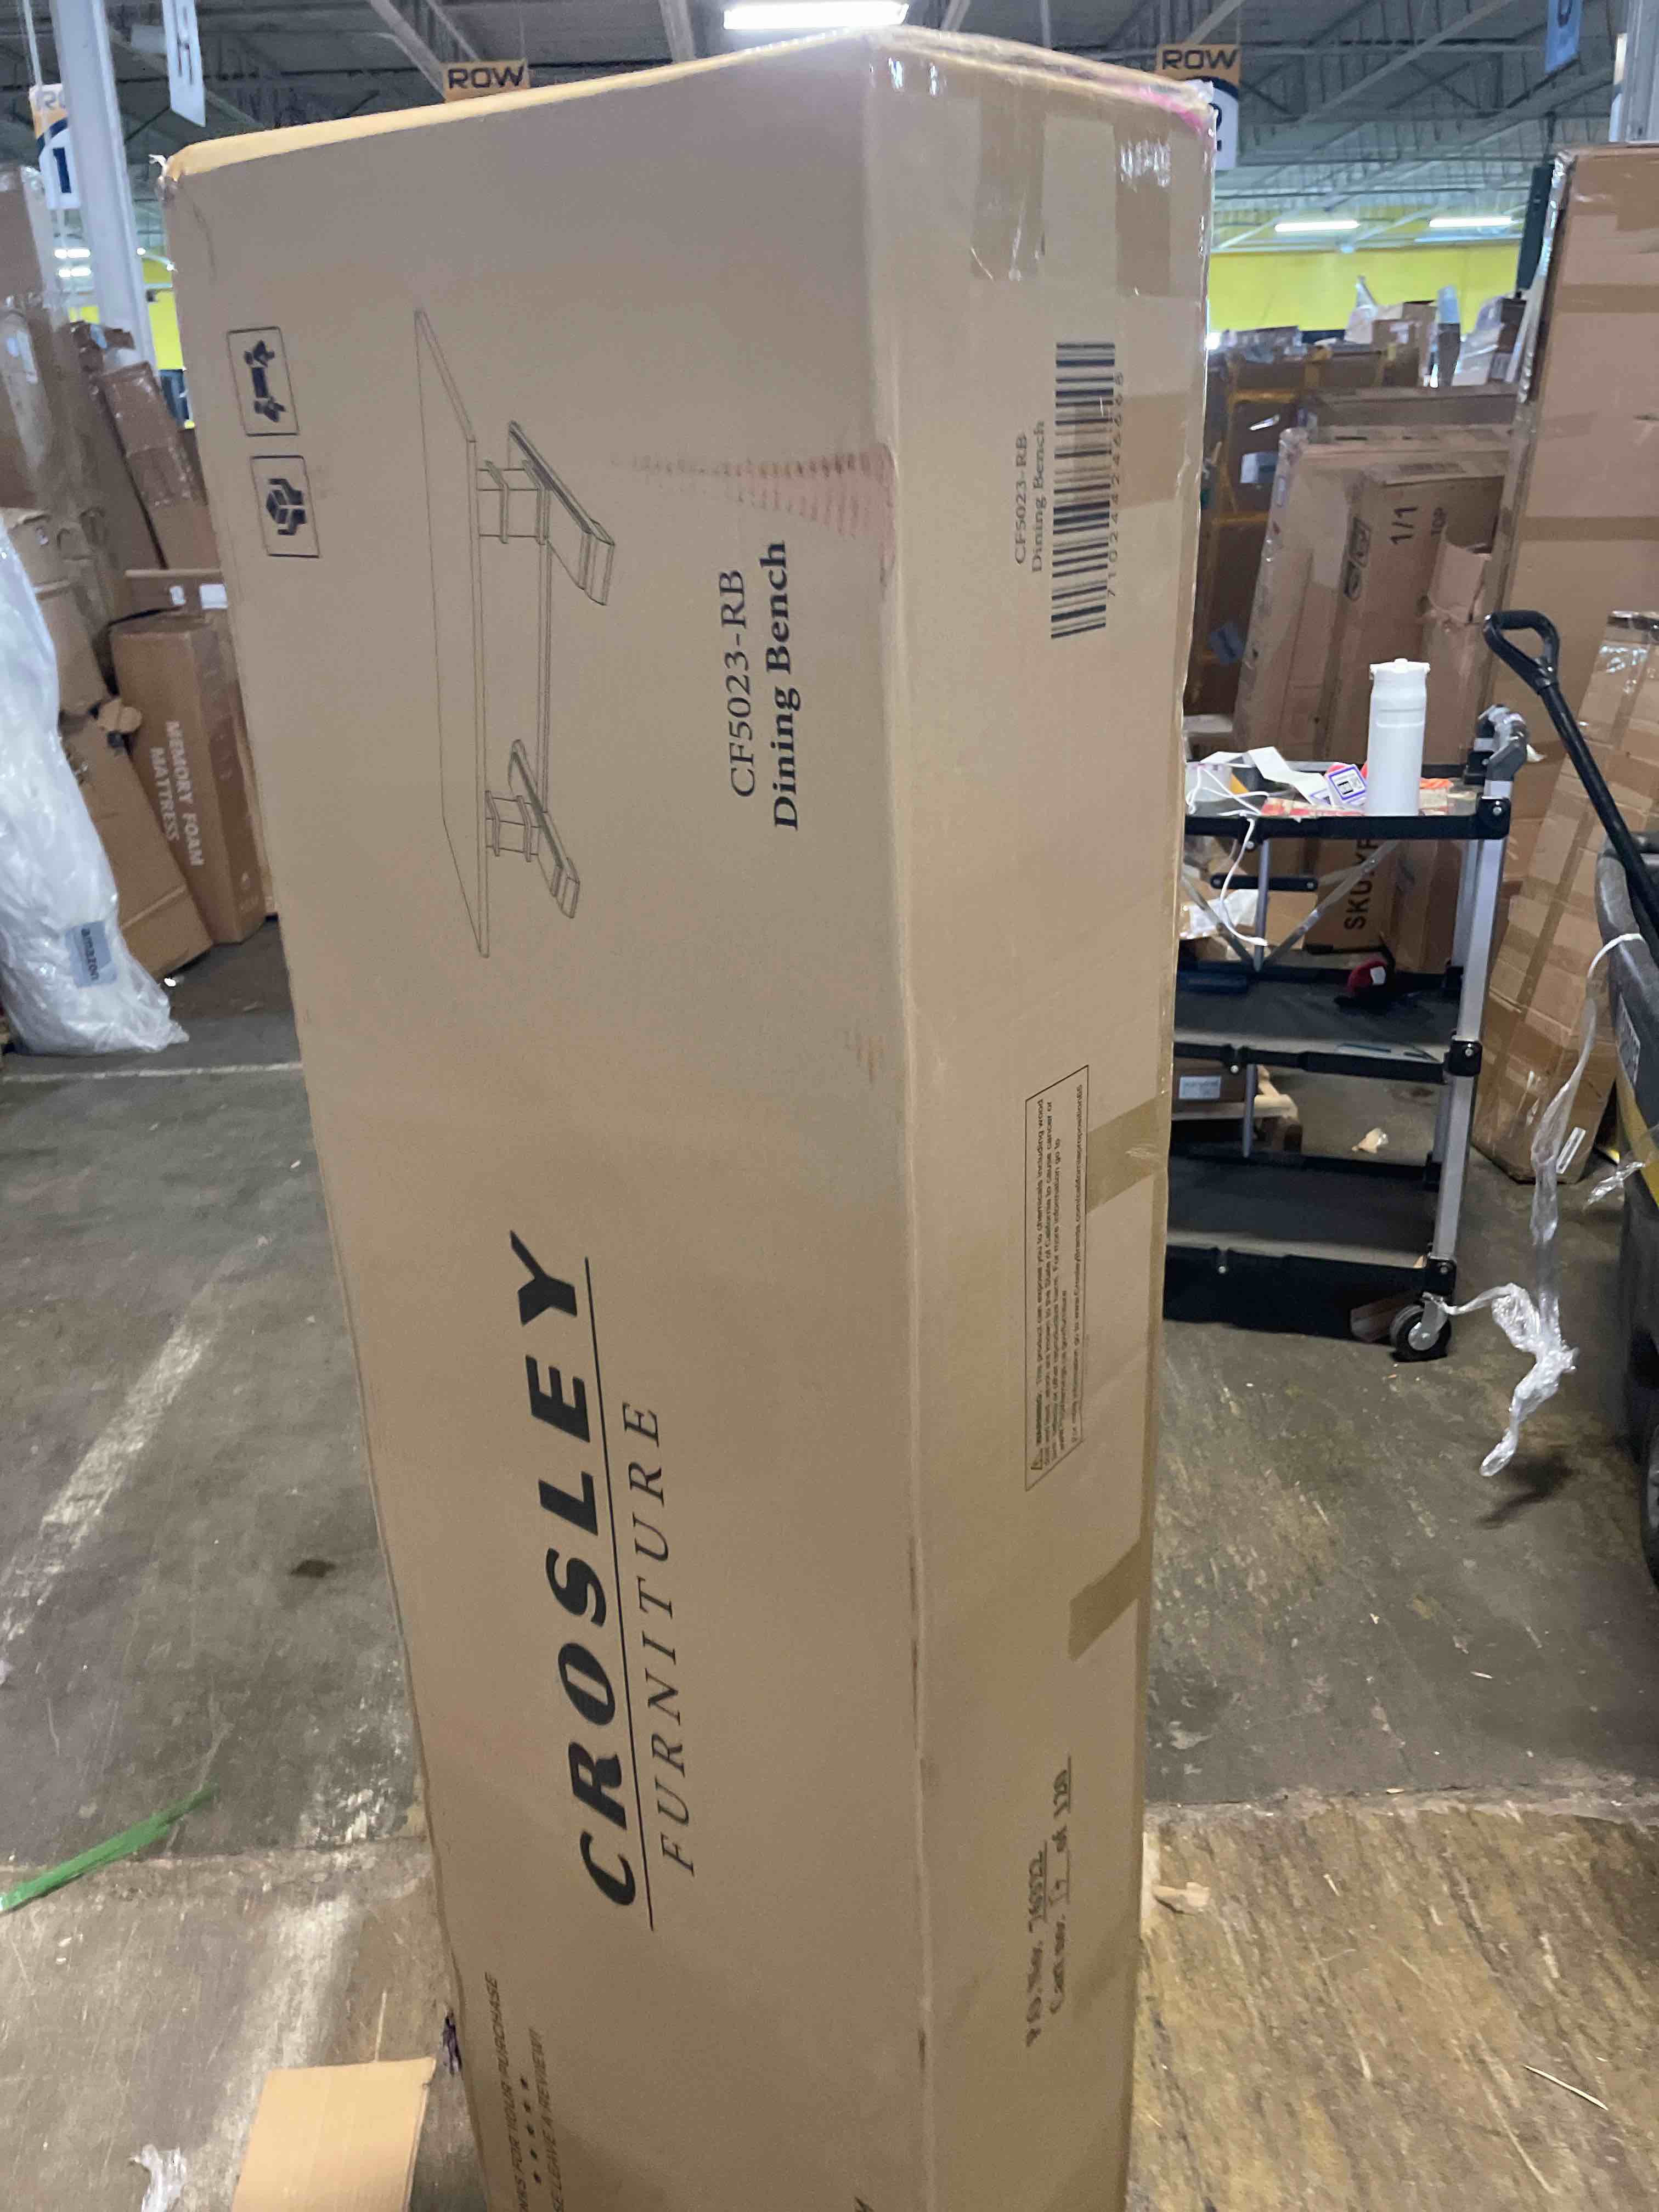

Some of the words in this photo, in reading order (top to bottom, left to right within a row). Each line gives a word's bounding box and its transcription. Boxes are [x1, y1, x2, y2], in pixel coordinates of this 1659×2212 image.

[448, 63, 525, 89] ROW
[1161, 49, 1239, 70] ROW
[53, 147, 71, 193] 1
[1032, 420, 1045, 490] Bench
[1014, 431, 1027, 566] CF5023-RB
[1031, 496, 1047, 573] Dining
[1388, 505, 1421, 544] 1/1
[760, 540, 791, 675] Bench
[719, 569, 755, 797] CF5023-RB
[150, 747, 180, 842] MATTRESS
[166, 720, 193, 803] MEMORY
[183, 812, 205, 866] FOAM
[771, 686, 800, 831] Dining
[510, 1229, 635, 1907] CROSLEY
[622, 1401, 695, 1875] FURNITURE
[484, 1972, 510, 2077] PURCHASE
[500, 2080, 518, 2132] YOUR
[508, 2135, 523, 2174] FOR
[542, 2129, 562, 2191] LEAVE
